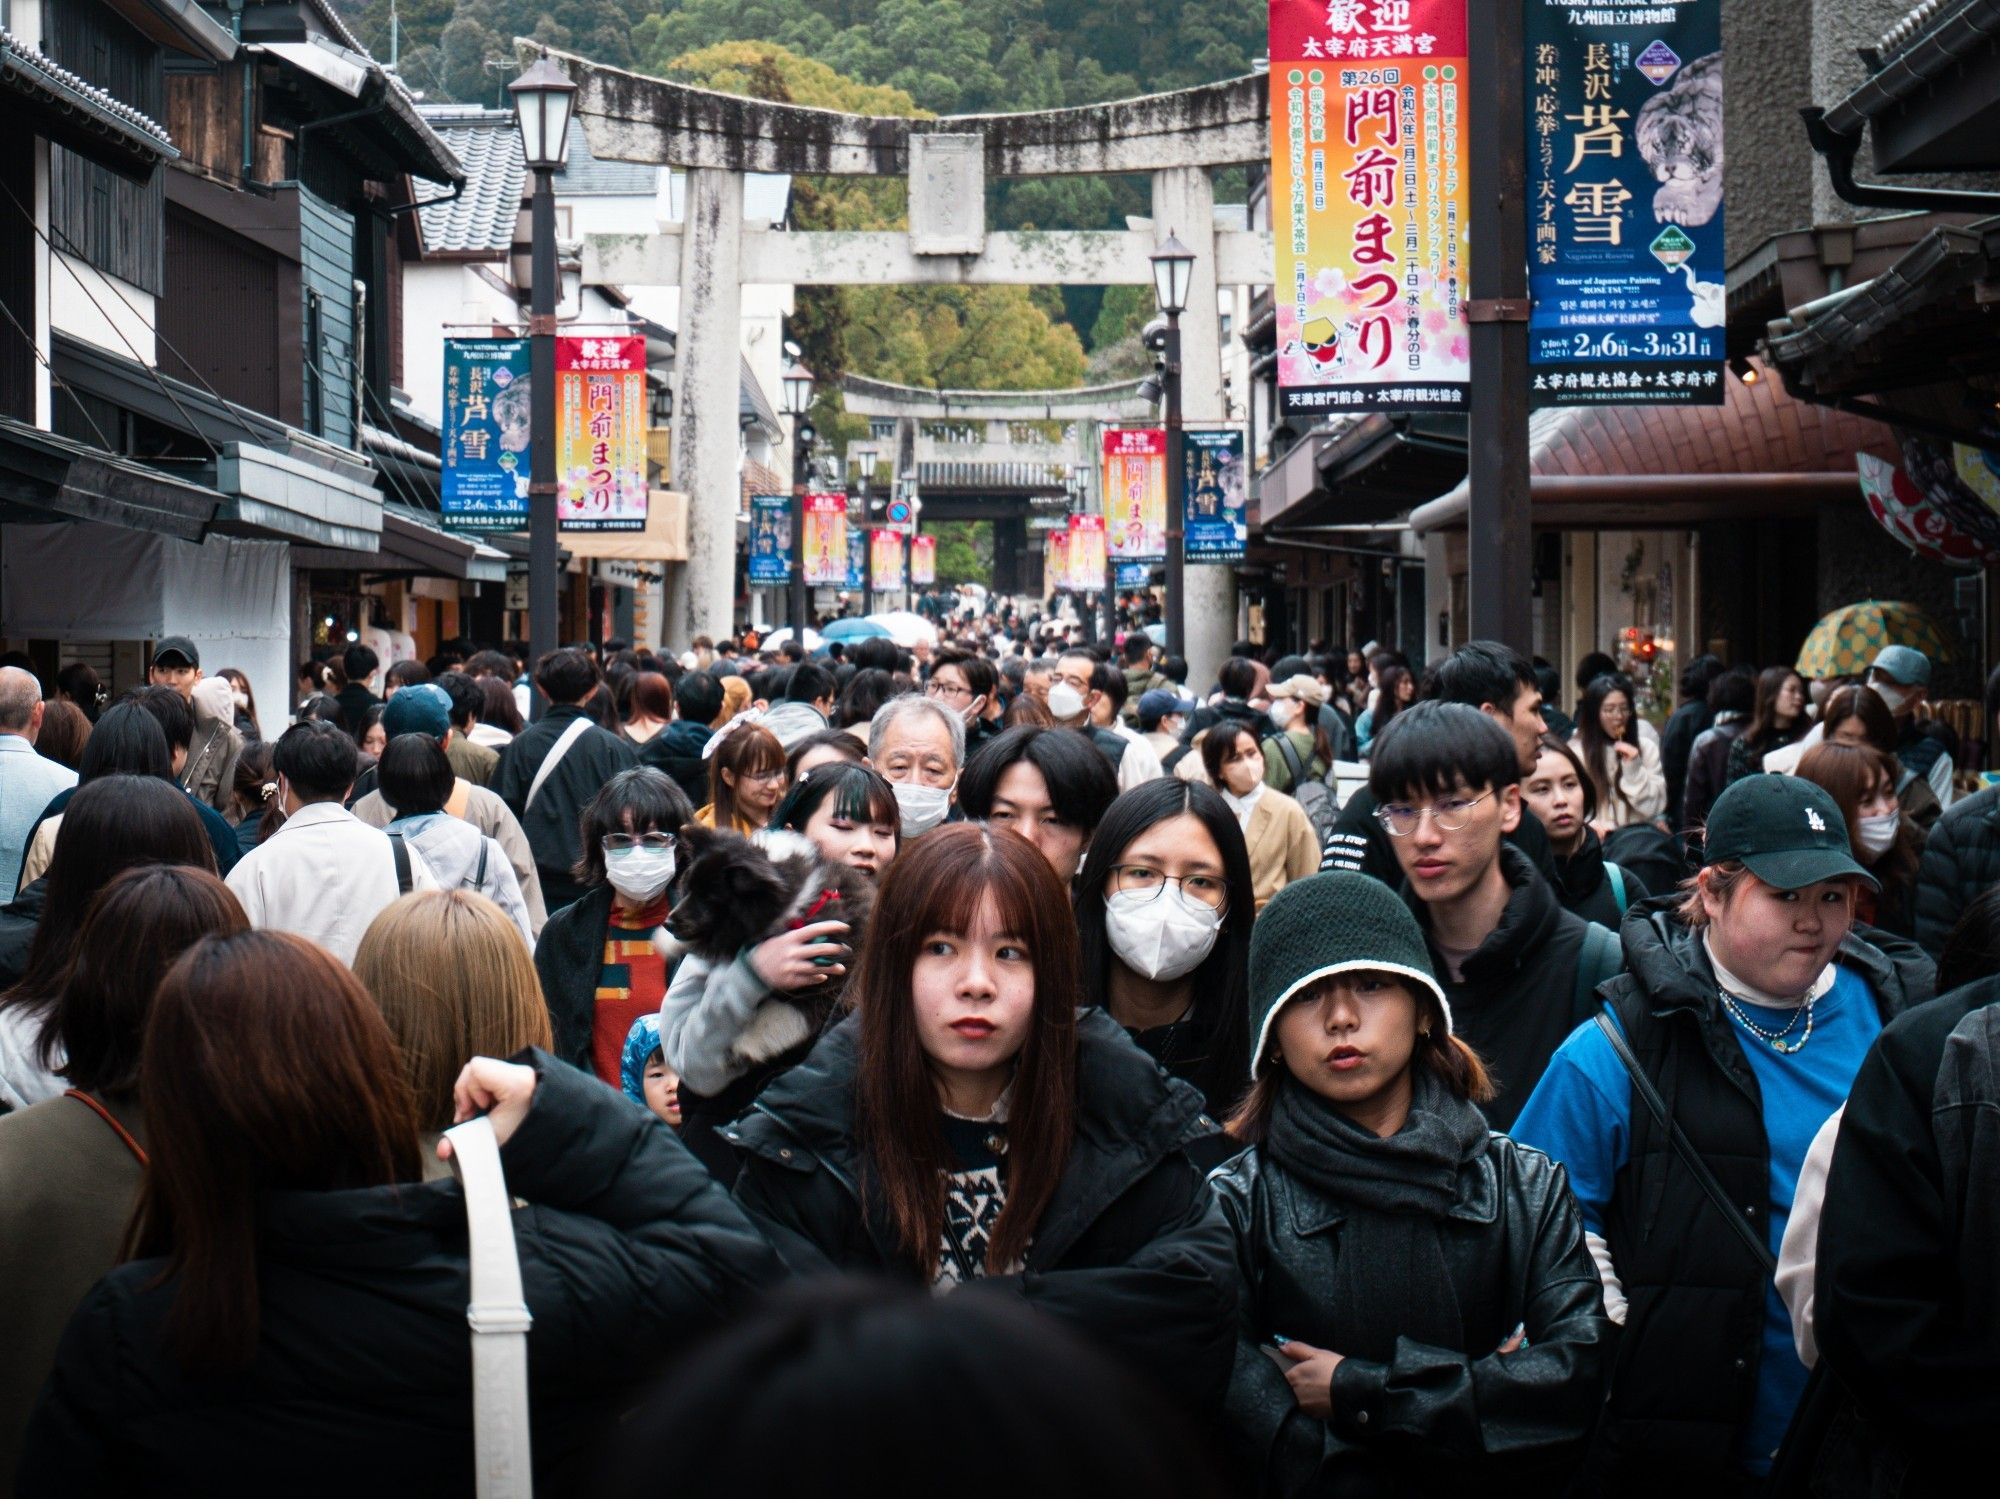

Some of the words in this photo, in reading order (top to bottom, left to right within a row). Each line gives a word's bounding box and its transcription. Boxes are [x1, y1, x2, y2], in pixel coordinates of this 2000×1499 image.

[1568, 8, 1676, 25] 九州国立博物館
[1302, 33, 1437, 58] 太宰府天満宮
[1341, 69, 1399, 86] 第26回
[1443, 83, 1457, 193] 門前まつりフェア
[1344, 88, 1398, 370] 門前まつり
[1556, 277, 1582, 285] Master
[1584, 277, 1593, 285] of
[1594, 277, 1627, 286] Japanese
[1629, 276, 1661, 285] Painting
[1541, 348, 1570, 358] (2024)
[1534, 371, 1717, 389] 太宰府観光協会・太宰府市
[1289, 388, 1462, 407] 天満宮門前会・太宰府観光協会
[588, 384, 613, 512] 門前まつり
